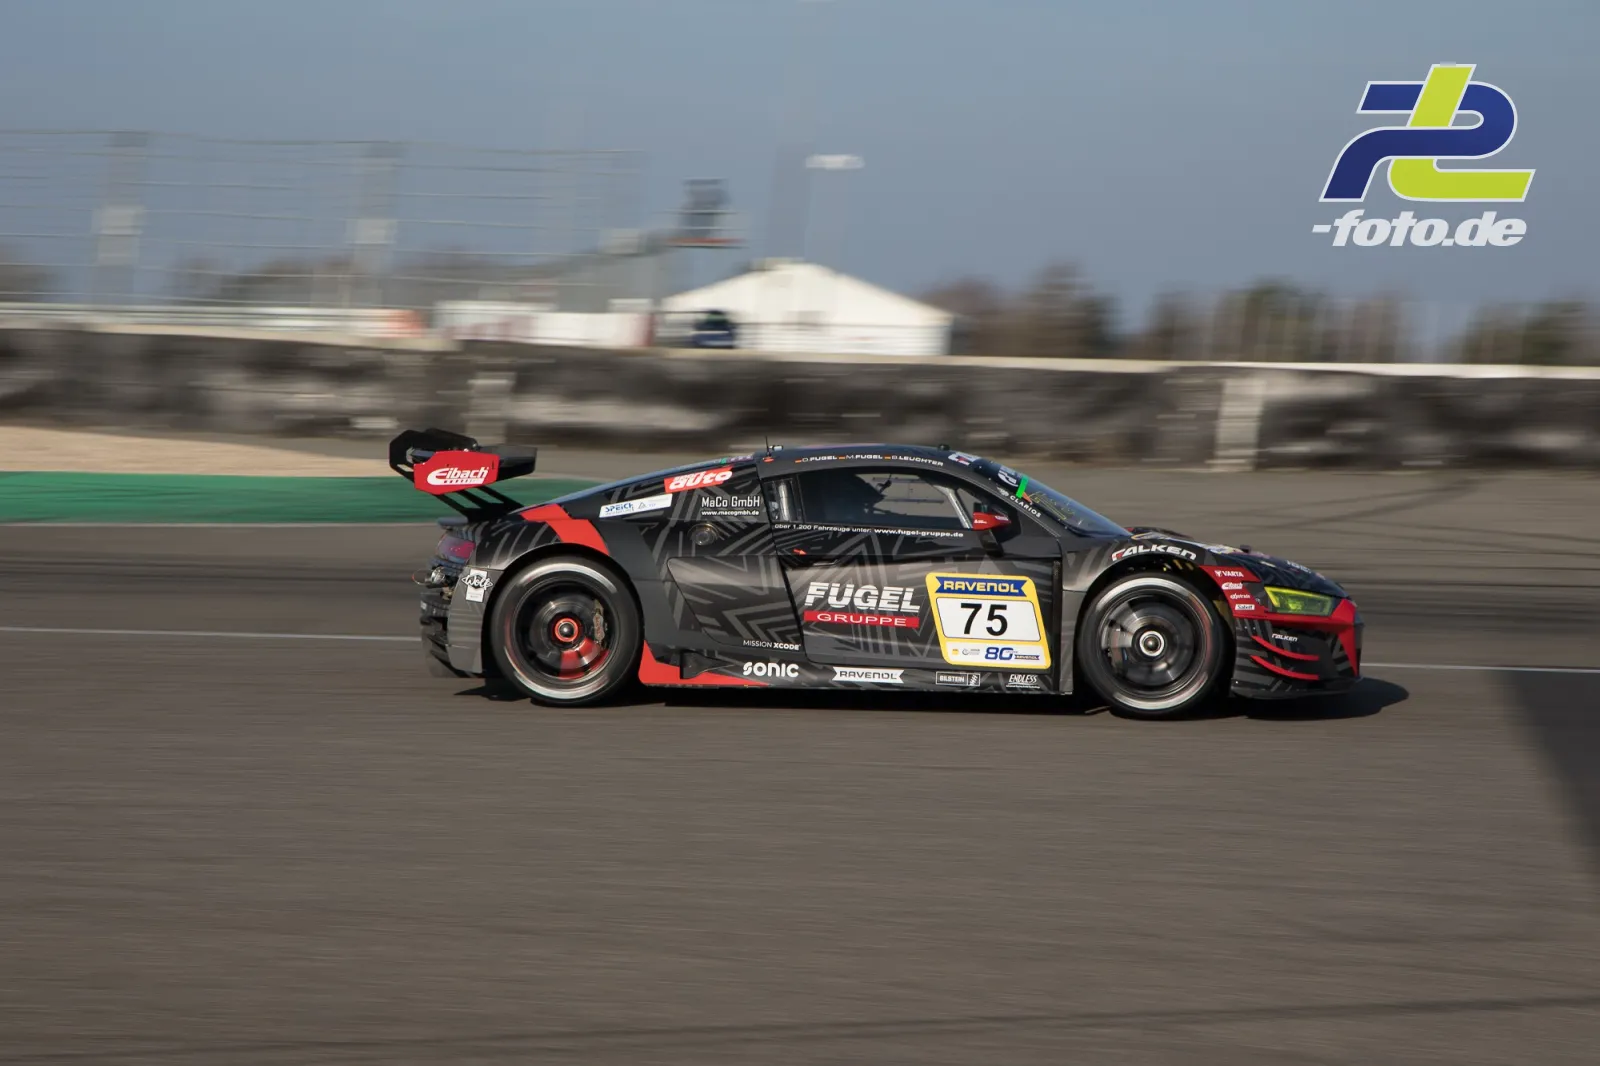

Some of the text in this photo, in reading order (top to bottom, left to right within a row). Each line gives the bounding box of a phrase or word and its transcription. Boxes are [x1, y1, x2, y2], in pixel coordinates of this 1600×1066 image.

[427, 466, 490, 486] Eibach
[668, 470, 733, 490] auto
[701, 495, 760, 508] MaCo GmbH
[1010, 495, 1042, 518] CLARIOS
[813, 524, 851, 533] Fahrzeuge
[1111, 544, 1197, 562] FALKEN
[1221, 570, 1245, 578] VARTA
[943, 580, 1019, 593] RAVENOL
[816, 613, 907, 627] GRUPPE
[960, 602, 1008, 637] 75
[1271, 633, 1298, 642] FALKEN
[743, 639, 800, 651] MISSION XCODE
[984, 646, 1014, 661] 80
[839, 670, 898, 680] RAVENOL
[939, 675, 965, 683] BILSTEIN
[1008, 673, 1038, 684] ENDLESS
